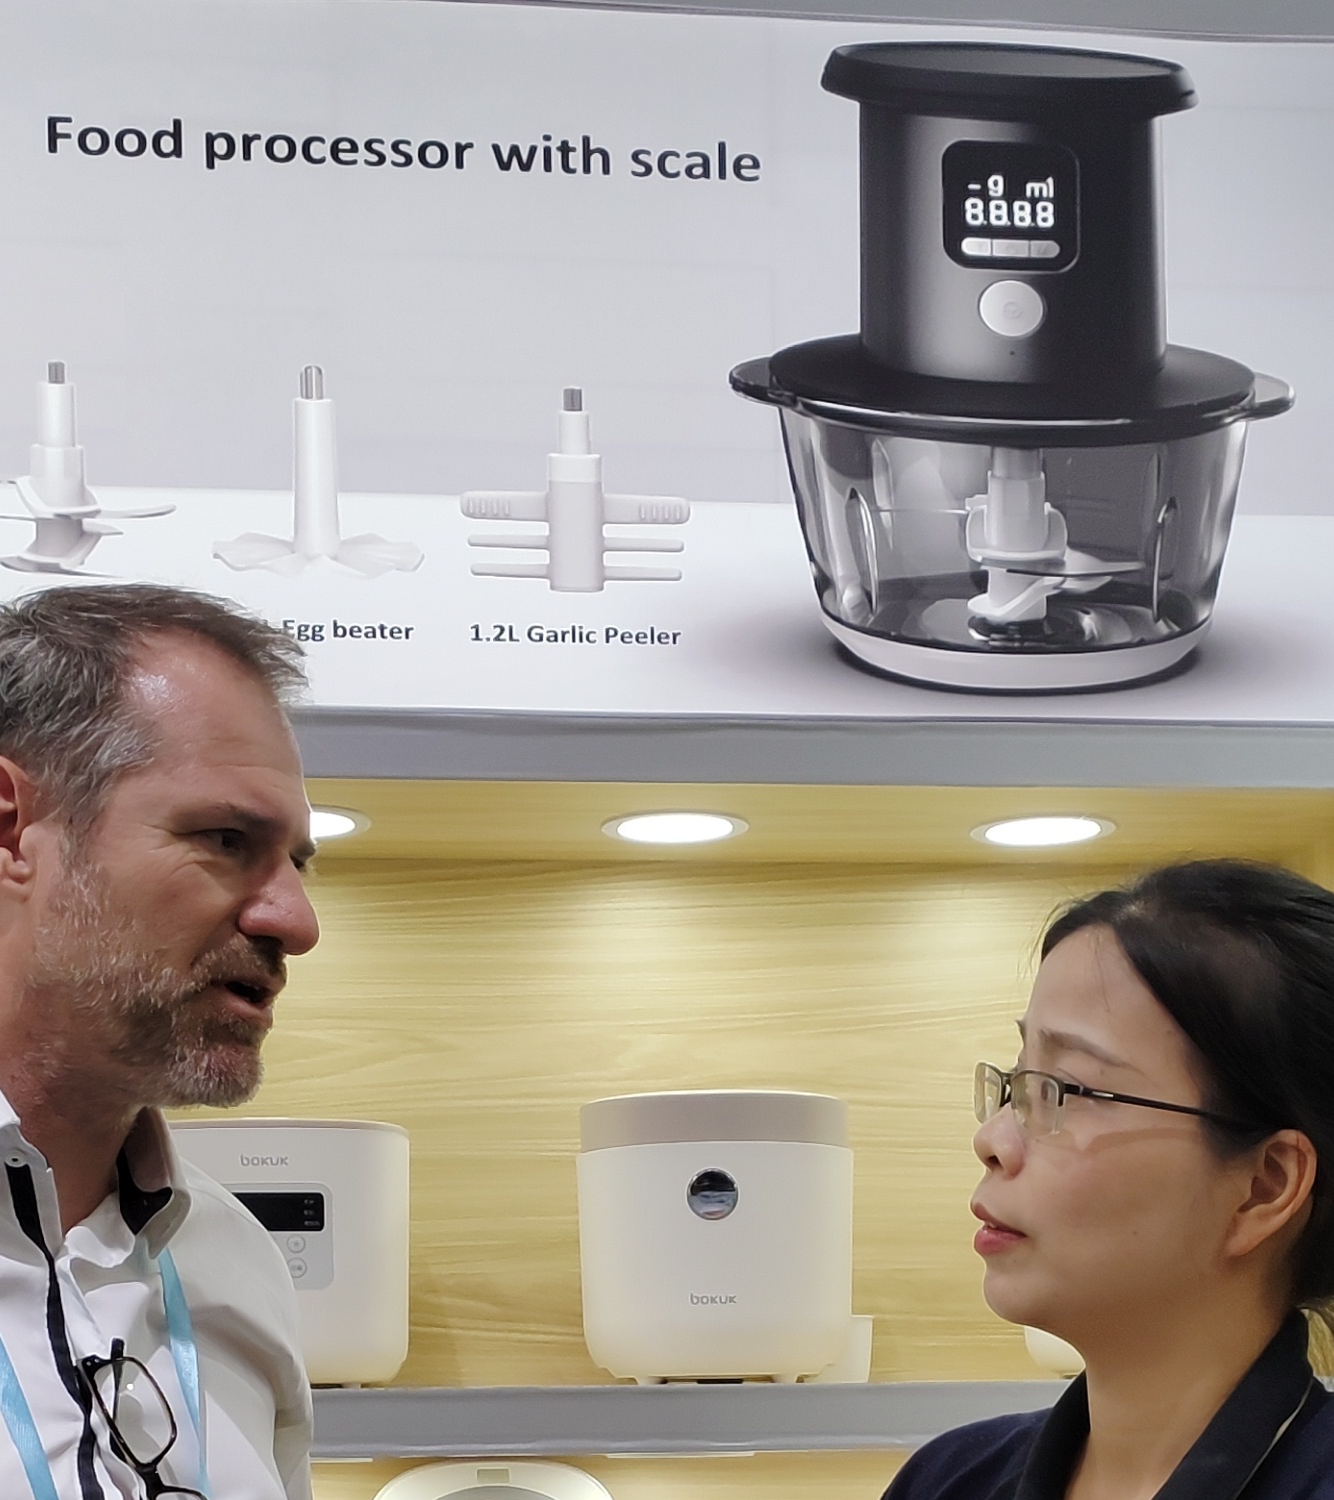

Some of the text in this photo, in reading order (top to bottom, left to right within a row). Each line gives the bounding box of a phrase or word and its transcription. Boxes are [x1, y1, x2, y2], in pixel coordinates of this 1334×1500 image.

[46, 115, 762, 182] Food processor with scale
[282, 618, 415, 642] Egg beater
[470, 623, 681, 646] 1.2L Garlic Peeler
